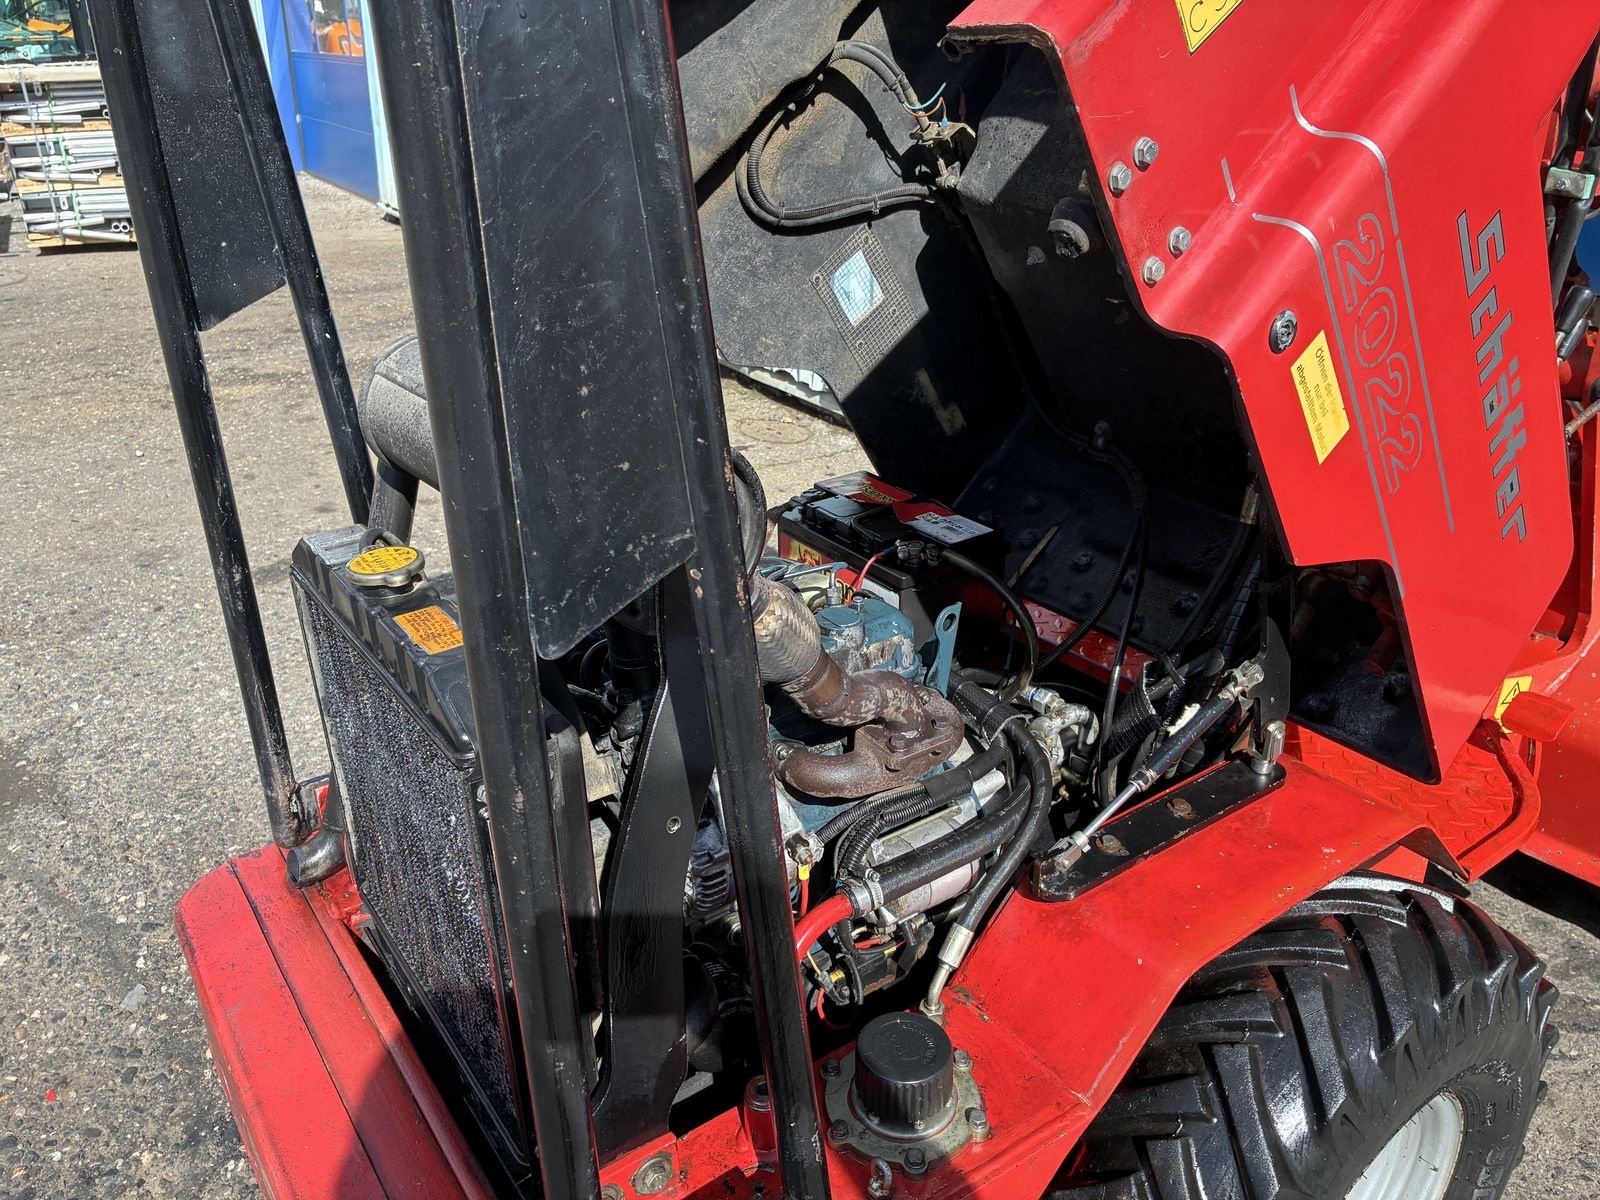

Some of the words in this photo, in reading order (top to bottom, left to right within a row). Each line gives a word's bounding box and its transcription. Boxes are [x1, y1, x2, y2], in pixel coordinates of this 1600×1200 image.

[1296, 364, 1319, 424] abgestelltem
[1314, 383, 1322, 399] nur
[1333, 213, 1422, 496] 2022
[1456, 209, 1528, 543] Schäffer
